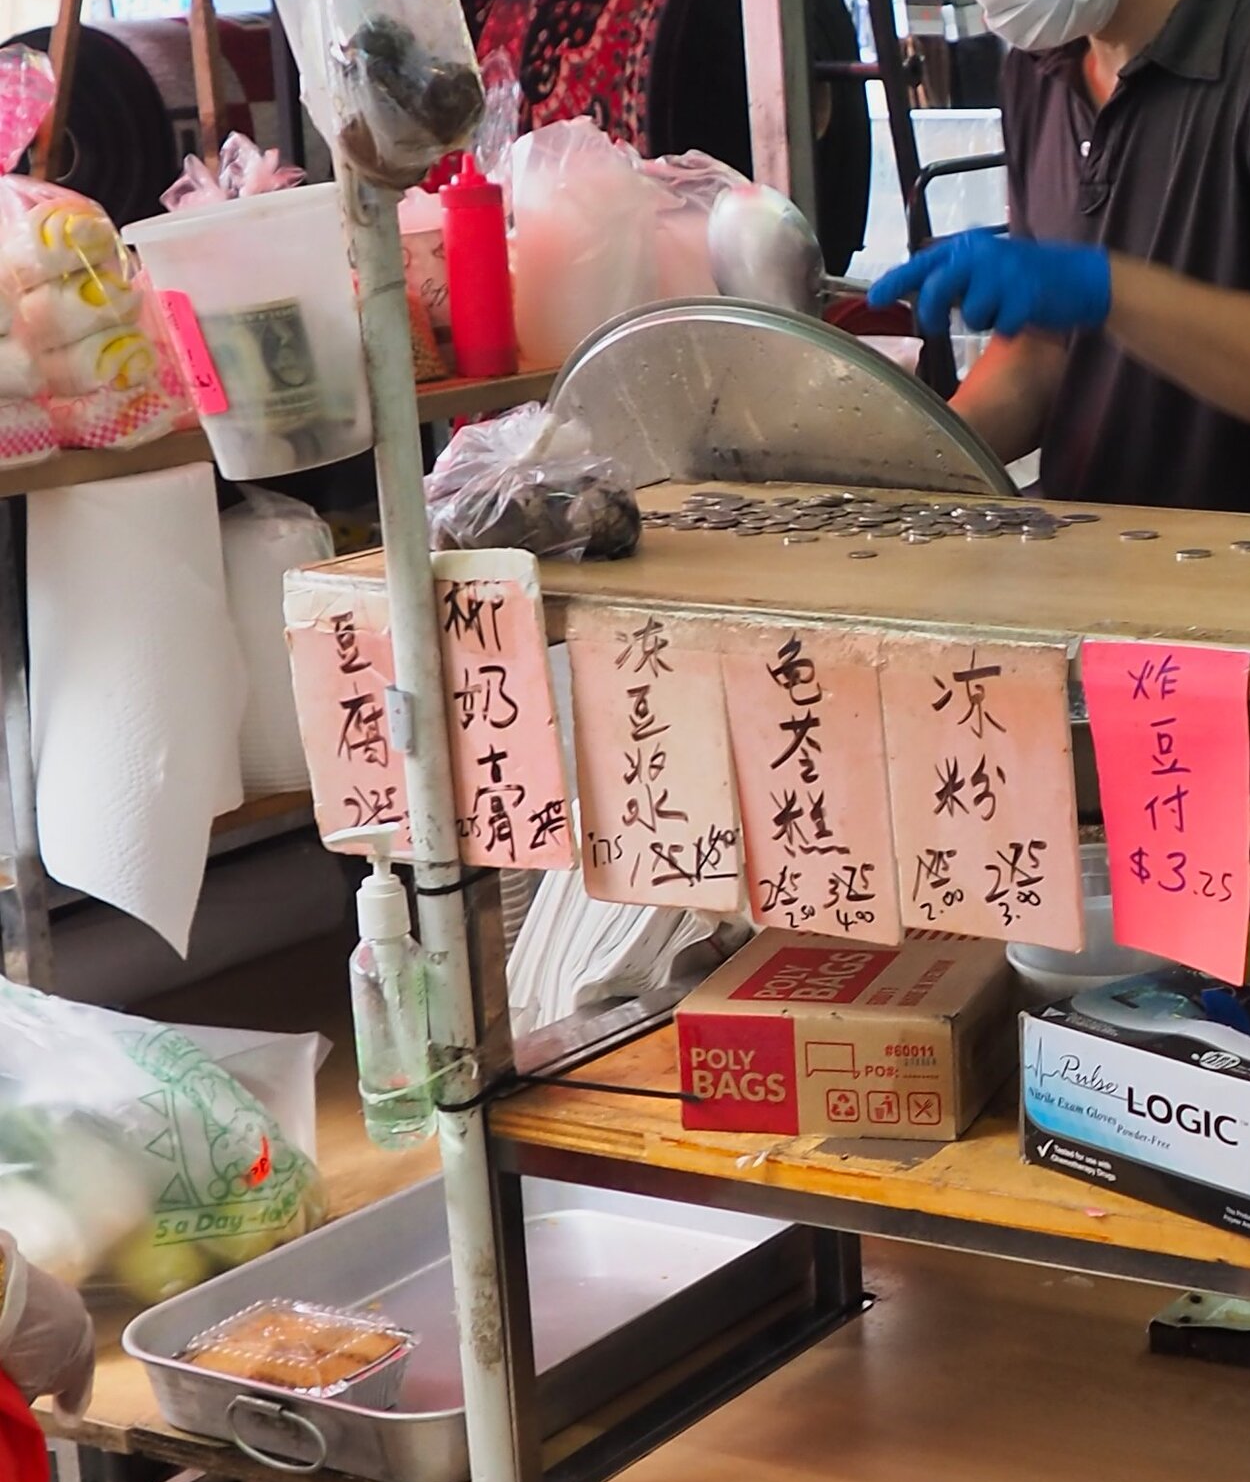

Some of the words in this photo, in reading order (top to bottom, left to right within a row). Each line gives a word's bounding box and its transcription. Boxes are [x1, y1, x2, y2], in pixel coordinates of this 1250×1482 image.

[753, 964, 807, 1000] POLY
[790, 949, 873, 1002] BAGS
[690, 1047, 756, 1070] POLY
[1060, 1054, 1119, 1095] Pulse
[692, 1073, 786, 1104] BAGS
[1058, 1096, 1084, 1115] Exam
[1086, 1106, 1117, 1126] Gloves
[1126, 1086, 1239, 1146] LOGIC
[194, 1213, 244, 1233] Day
